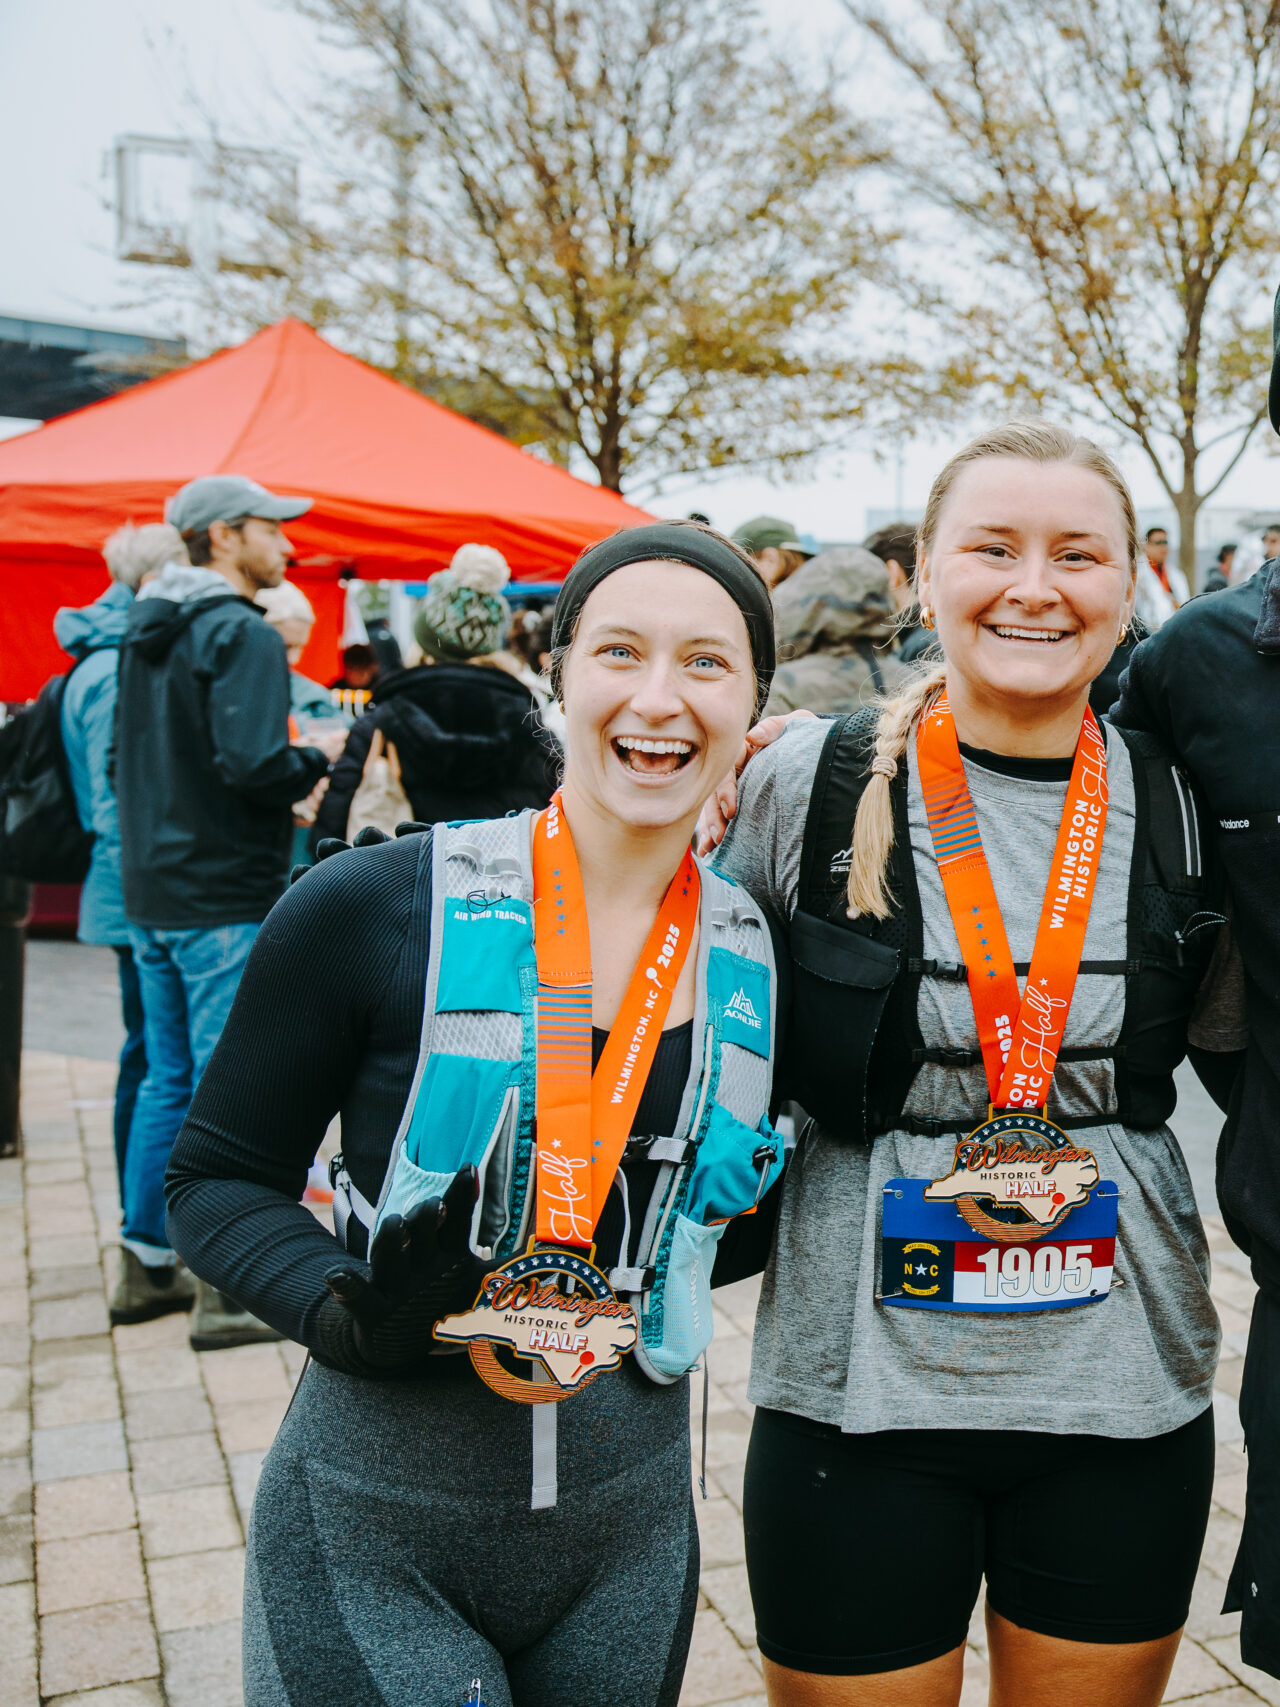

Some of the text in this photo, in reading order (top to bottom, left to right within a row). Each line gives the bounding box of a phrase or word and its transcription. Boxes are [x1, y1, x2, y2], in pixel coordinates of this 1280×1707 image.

[1080, 718, 1109, 805] Half
[1050, 799, 1089, 929] WILMINGTON
[1073, 804, 1102, 898] HISTORIC
[454, 909, 527, 925] AIR WIND TRACKER
[656, 923, 681, 968] 2025
[611, 989, 658, 1104] WILMINGTON, NC
[1020, 986, 1067, 1074] Half
[957, 1138, 1090, 1174] Wilmington
[980, 1171, 1036, 1180] HISTORIC
[538, 1150, 593, 1243] Half
[1006, 1180, 1056, 1198] HALF
[904, 1264, 939, 1277] N C
[977, 1245, 1093, 1297] 1905
[483, 1271, 635, 1327] Wilmington
[504, 1314, 569, 1331] HISTORIC
[529, 1329, 589, 1352] HALF
